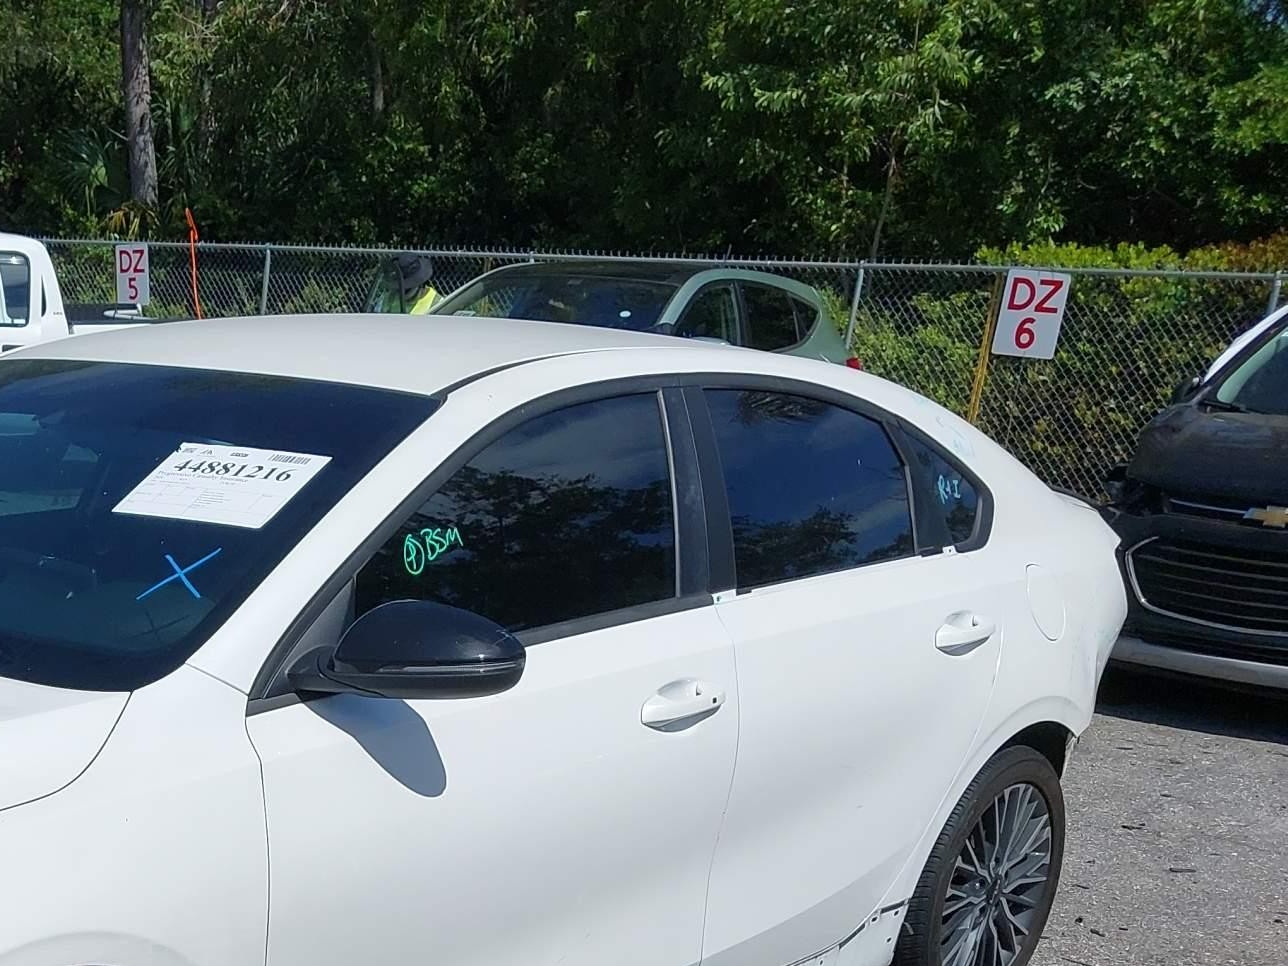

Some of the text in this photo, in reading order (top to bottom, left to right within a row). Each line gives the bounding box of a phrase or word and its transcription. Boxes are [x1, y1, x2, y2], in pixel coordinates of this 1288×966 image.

[119, 249, 145, 274] DZ
[128, 277, 139, 301] 5
[1007, 277, 1064, 314] DZ
[1014, 317, 1037, 350] 6
[173, 459, 299, 482] 44881216
[420, 527, 464, 561] BSM
